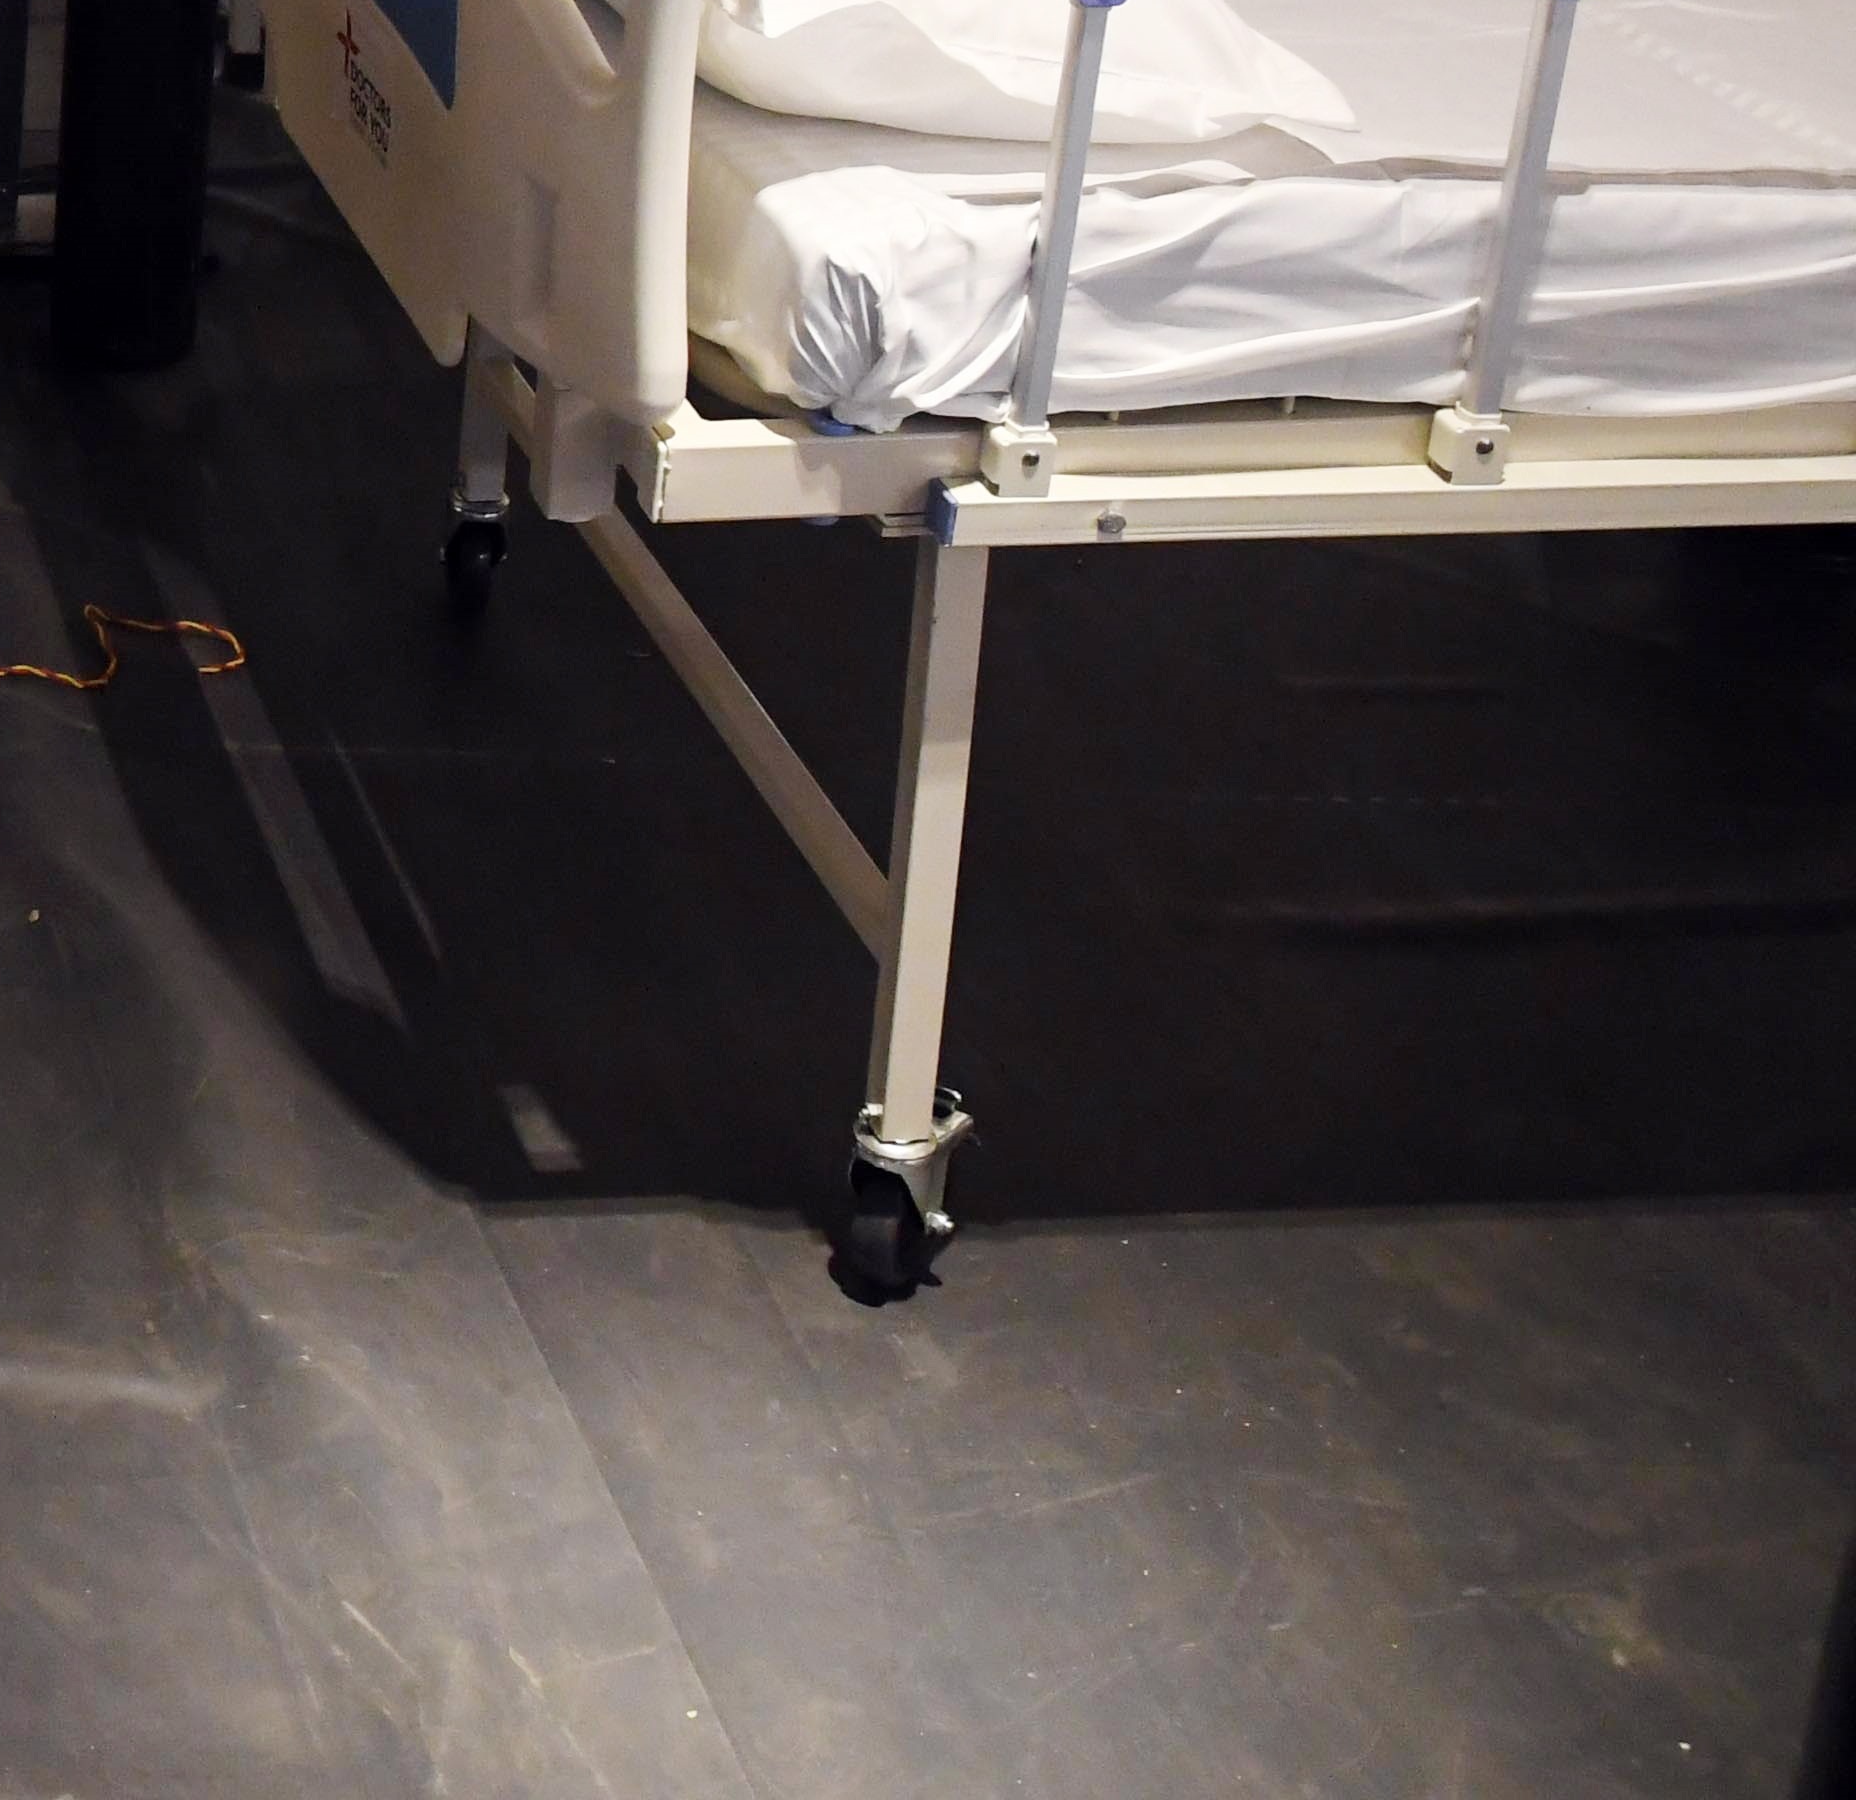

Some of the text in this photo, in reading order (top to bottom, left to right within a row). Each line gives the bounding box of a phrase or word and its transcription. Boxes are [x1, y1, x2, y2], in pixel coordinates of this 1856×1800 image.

[350, 59, 391, 129] DOCTORS
[350, 86, 367, 126] FOR
[370, 111, 388, 153] YOU
